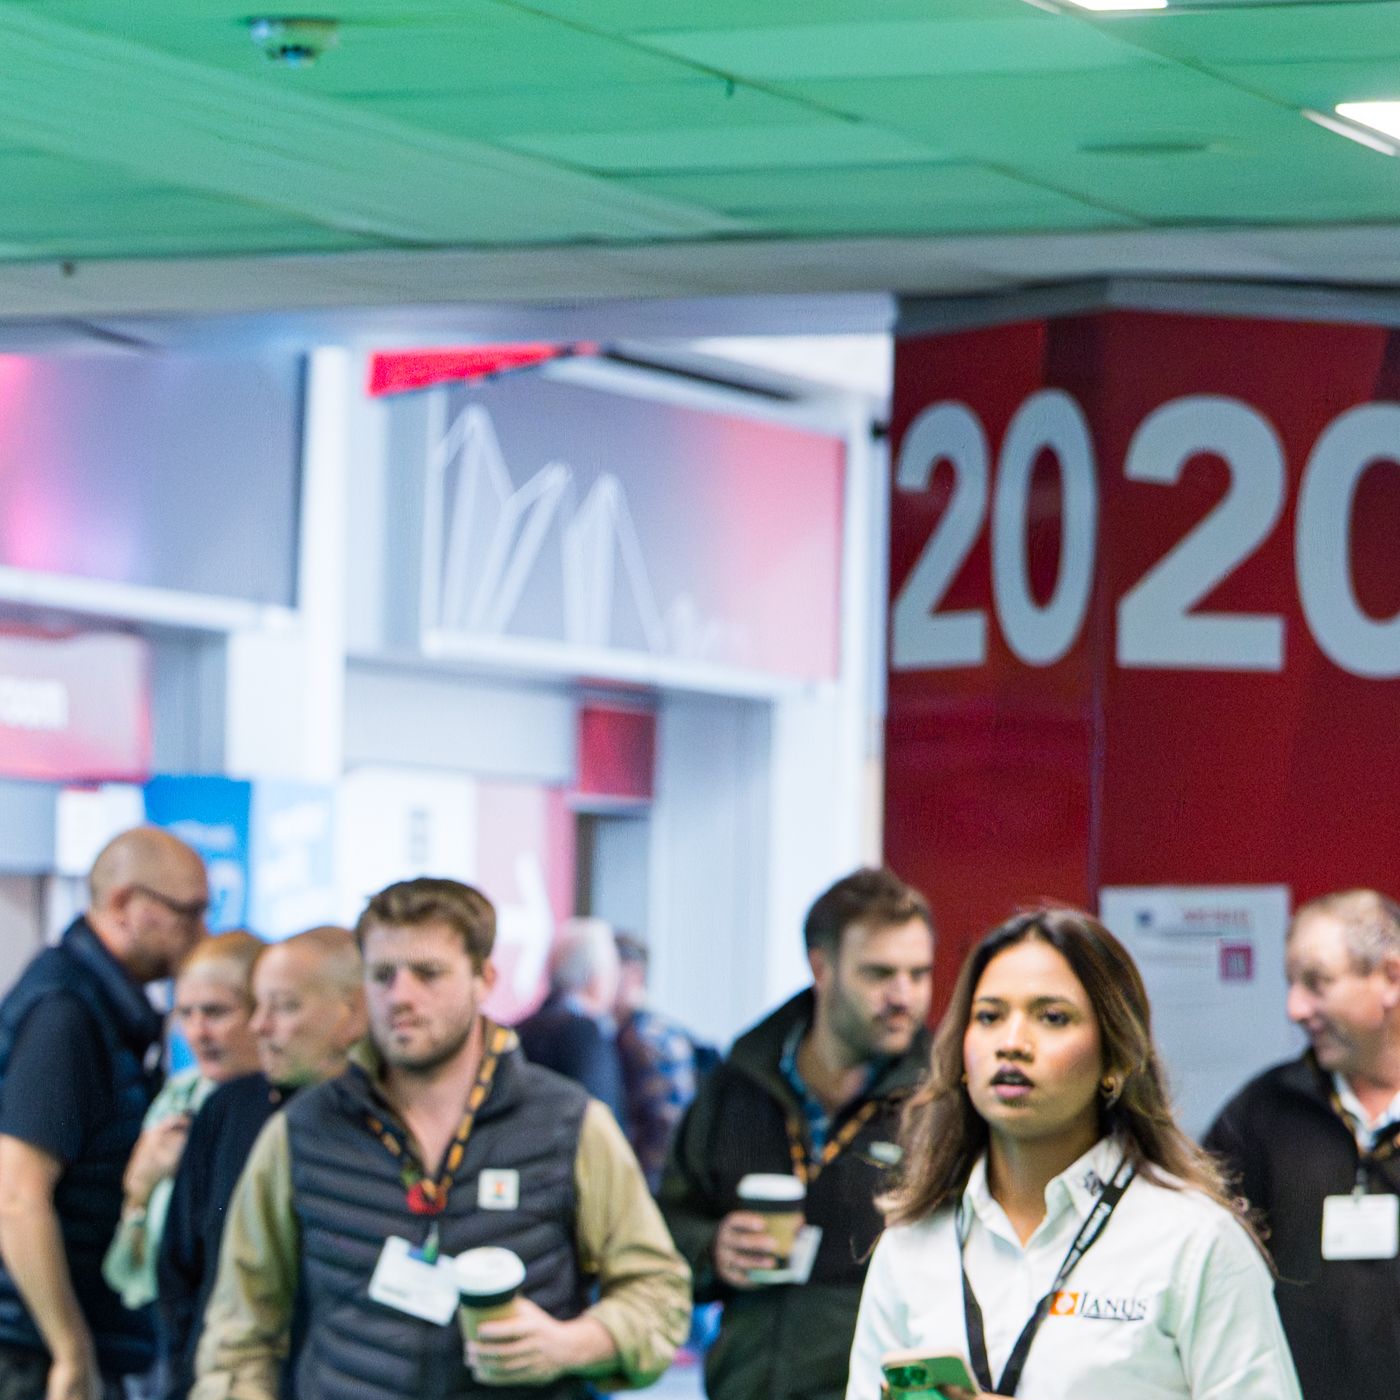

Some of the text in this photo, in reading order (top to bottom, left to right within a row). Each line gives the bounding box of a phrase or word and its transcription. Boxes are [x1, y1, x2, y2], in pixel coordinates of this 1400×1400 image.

[892, 388, 1100, 671] 20
[1115, 394, 1400, 680] 20
[1080, 1291, 1148, 1316] JANUS
